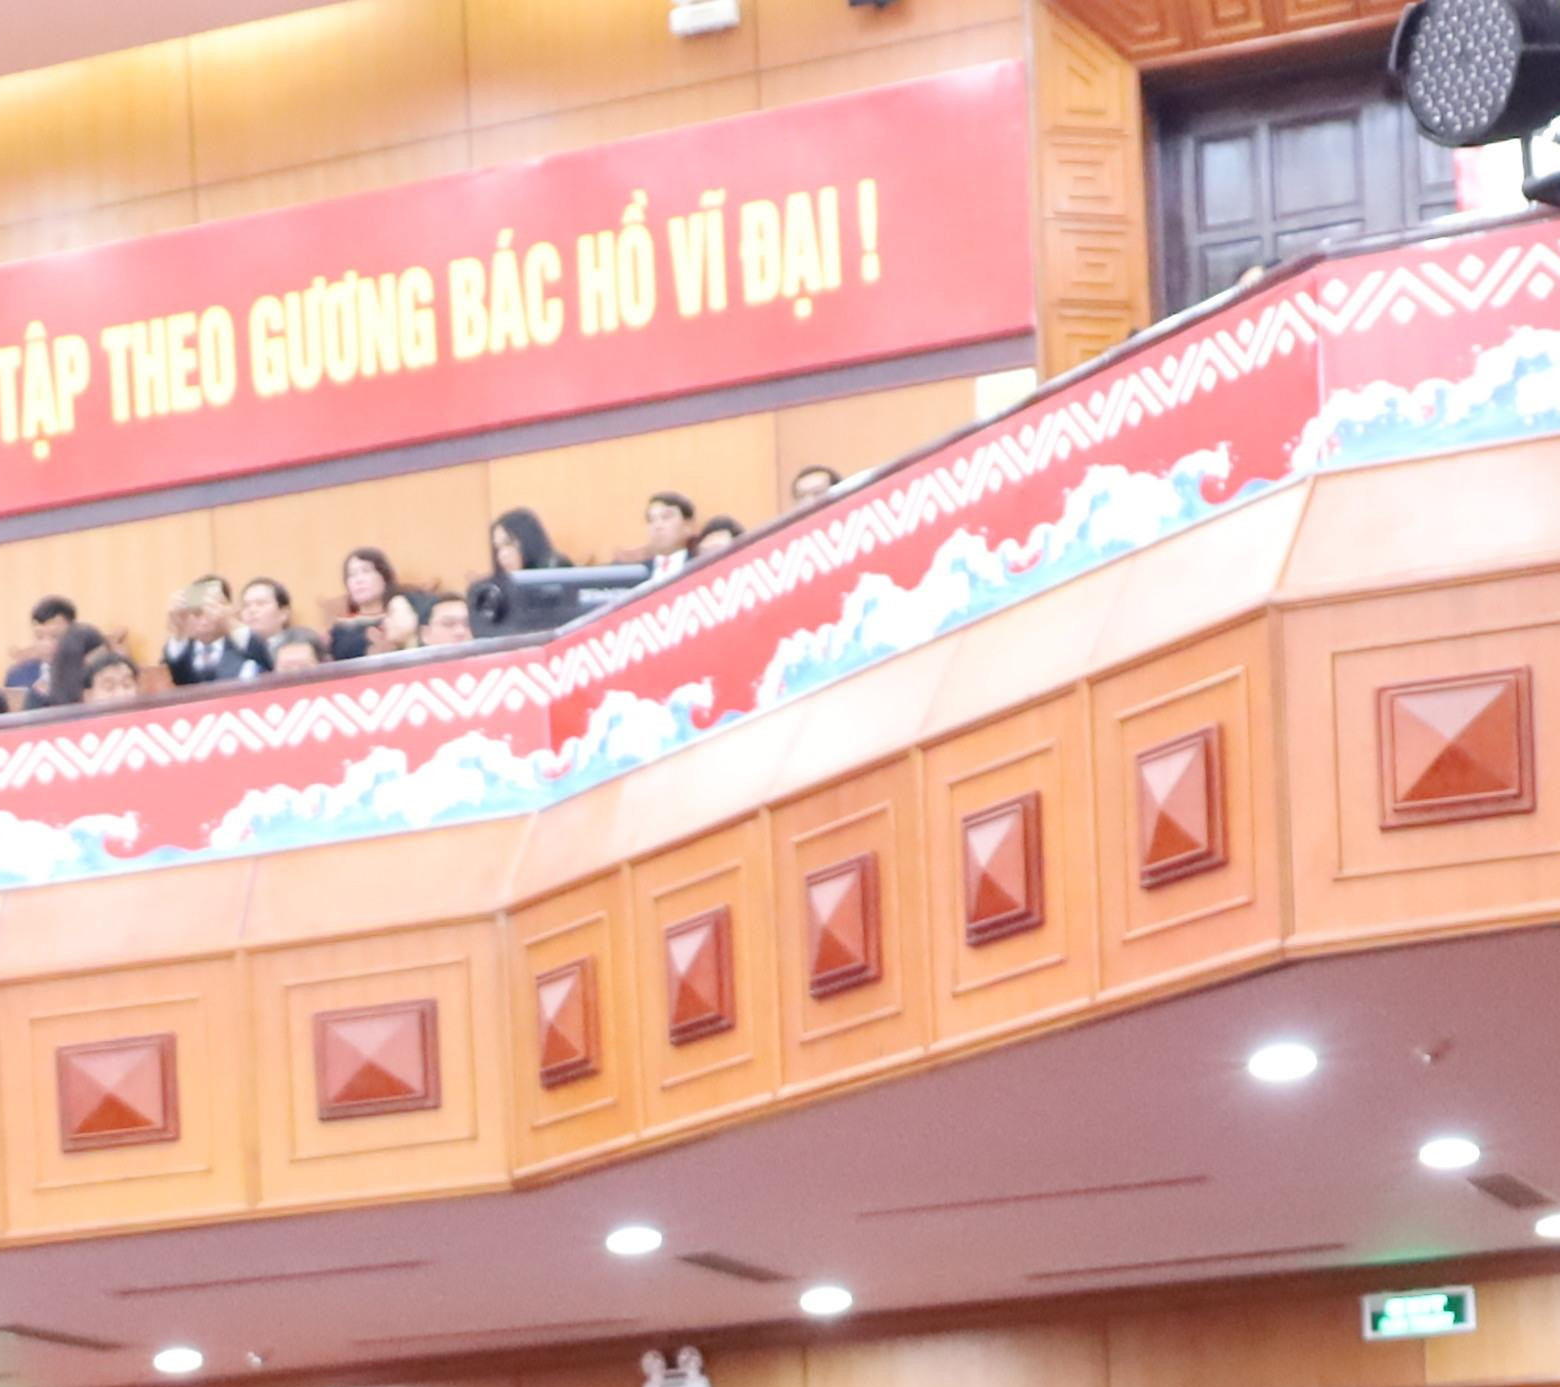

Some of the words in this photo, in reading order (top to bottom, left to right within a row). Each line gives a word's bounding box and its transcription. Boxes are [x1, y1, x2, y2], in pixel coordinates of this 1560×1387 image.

[102, 305, 236, 422] THEO
[248, 267, 437, 398] GƯƠNG
[448, 227, 564, 359] BÁC
[577, 189, 656, 336] HỒ
[668, 188, 727, 319] VĨ
[739, 186, 842, 319] ĐẠI
[858, 178, 880, 283] !
